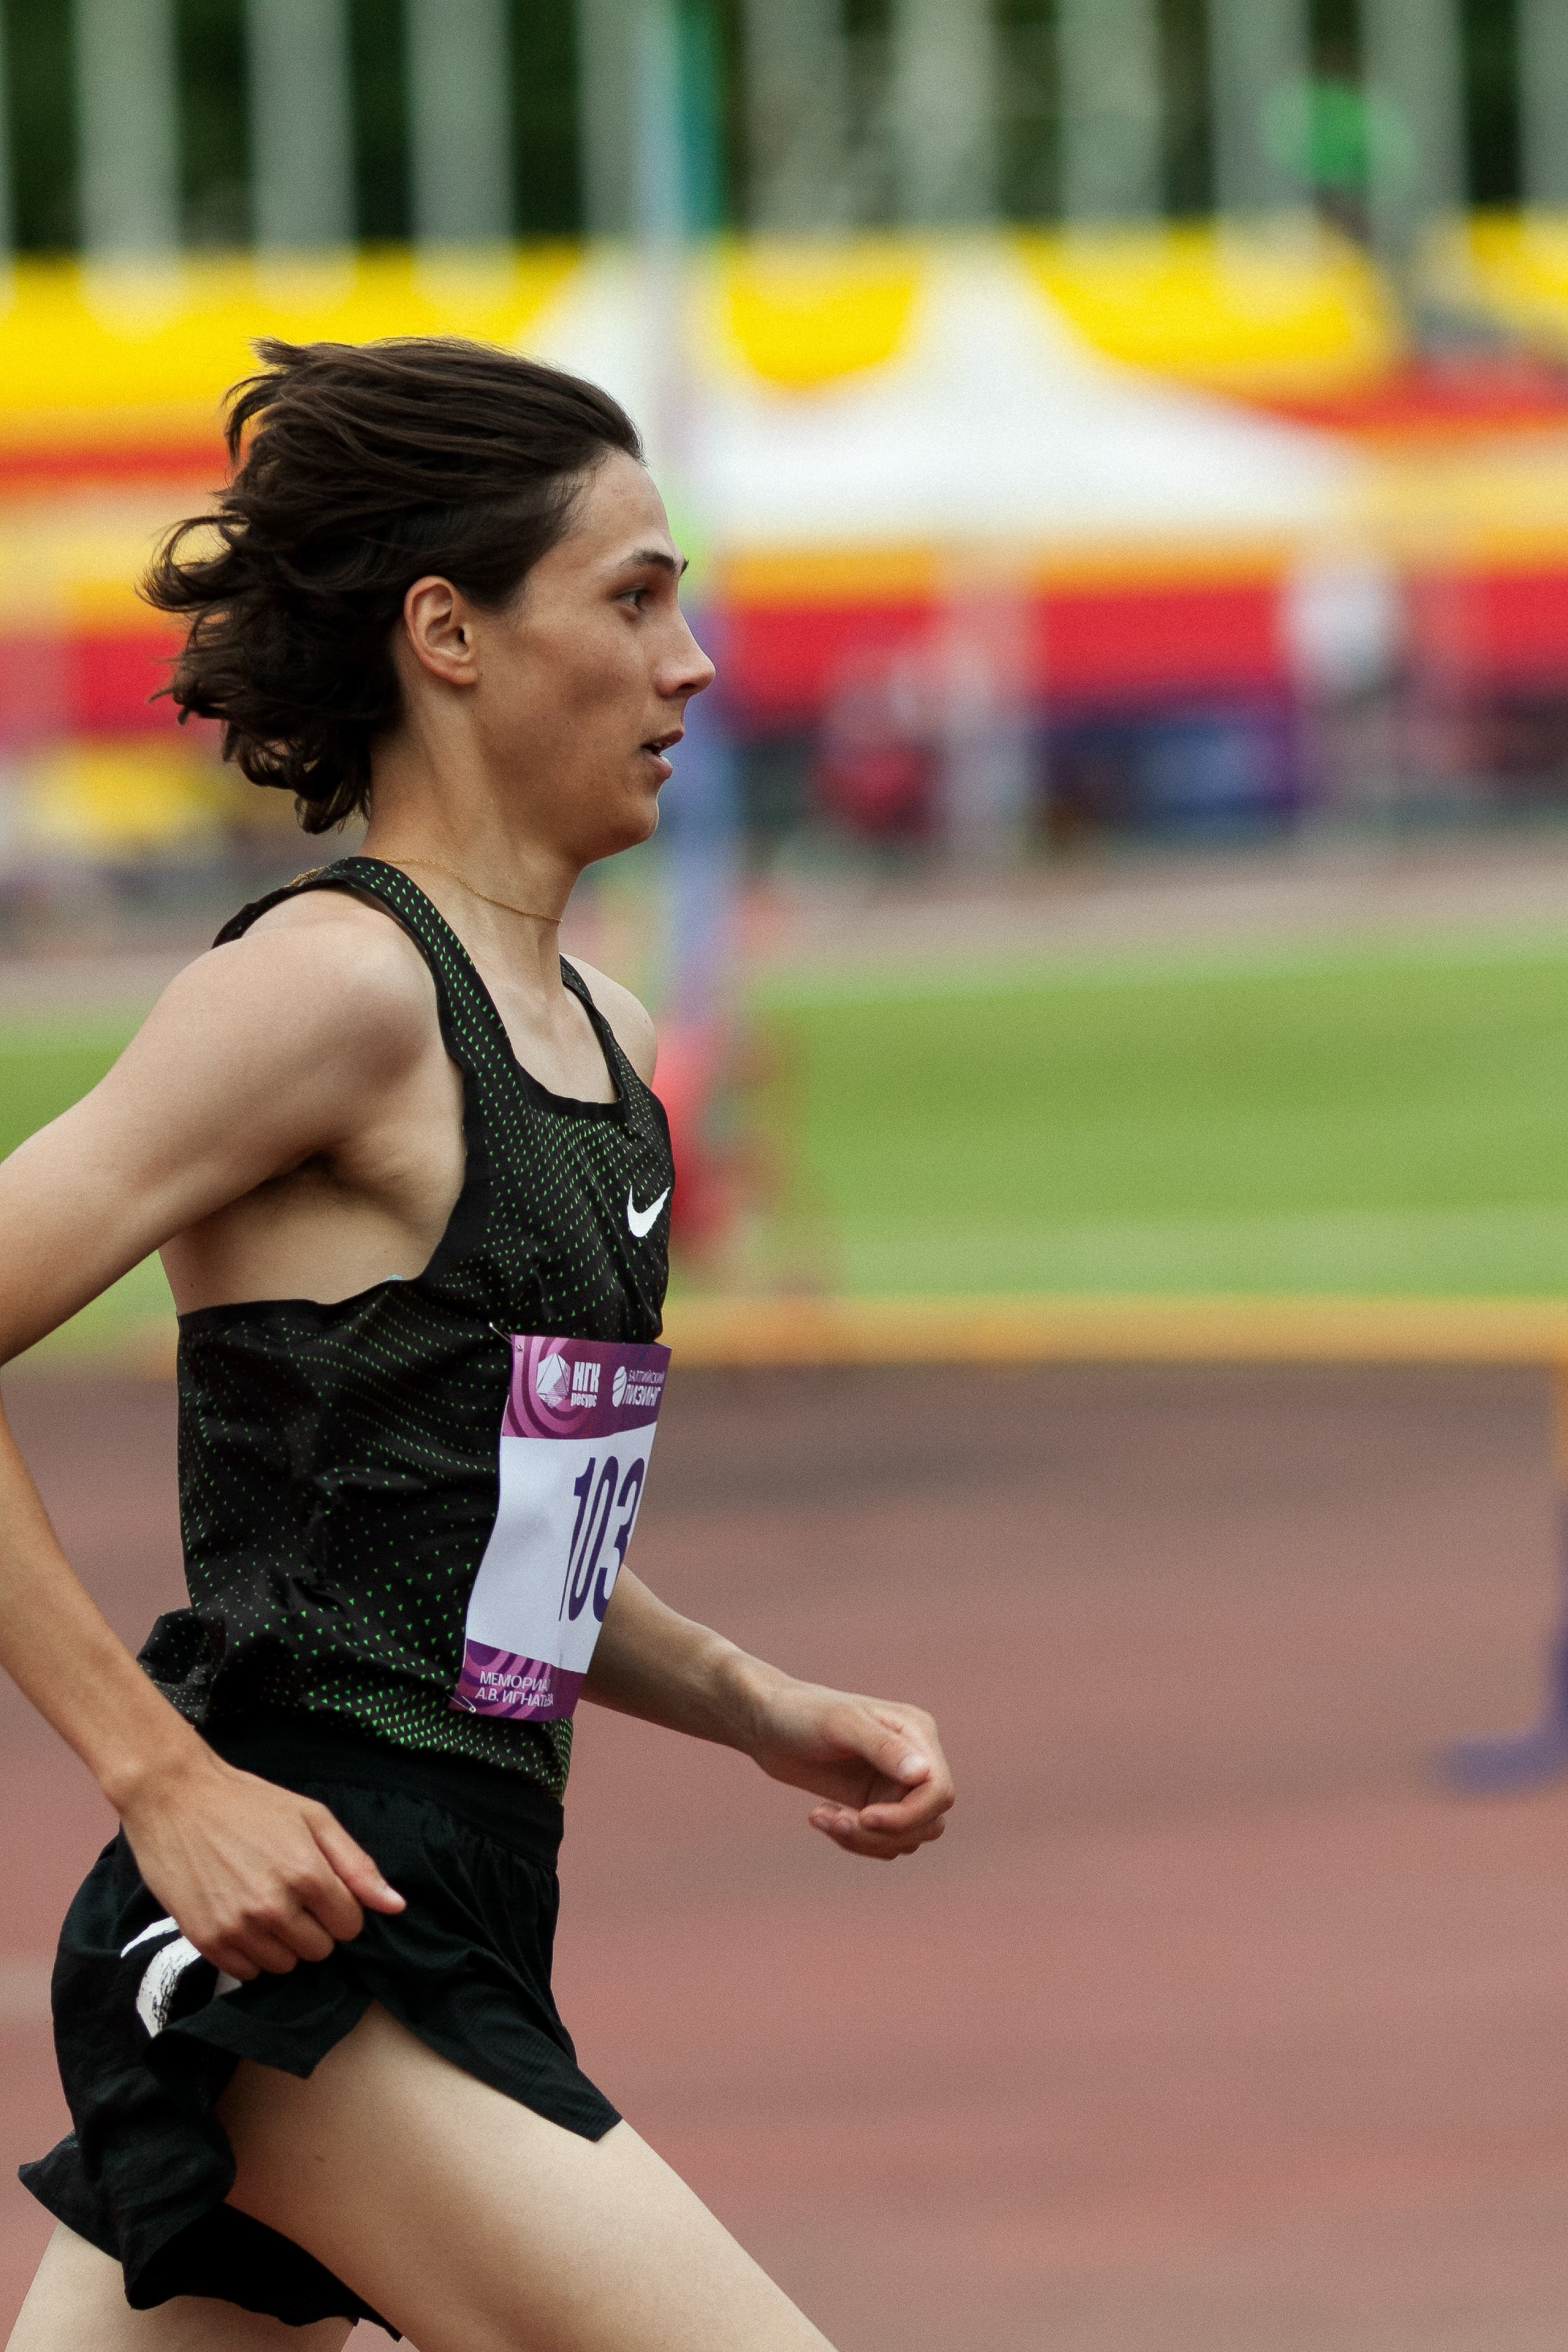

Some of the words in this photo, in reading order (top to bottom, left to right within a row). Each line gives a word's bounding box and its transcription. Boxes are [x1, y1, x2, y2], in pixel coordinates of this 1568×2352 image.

[572, 1361, 600, 1392] НГК
[570, 1392, 598, 1408] ресурс
[559, 1455, 644, 1622] 103
[475, 1688, 499, 1701] А.В.
